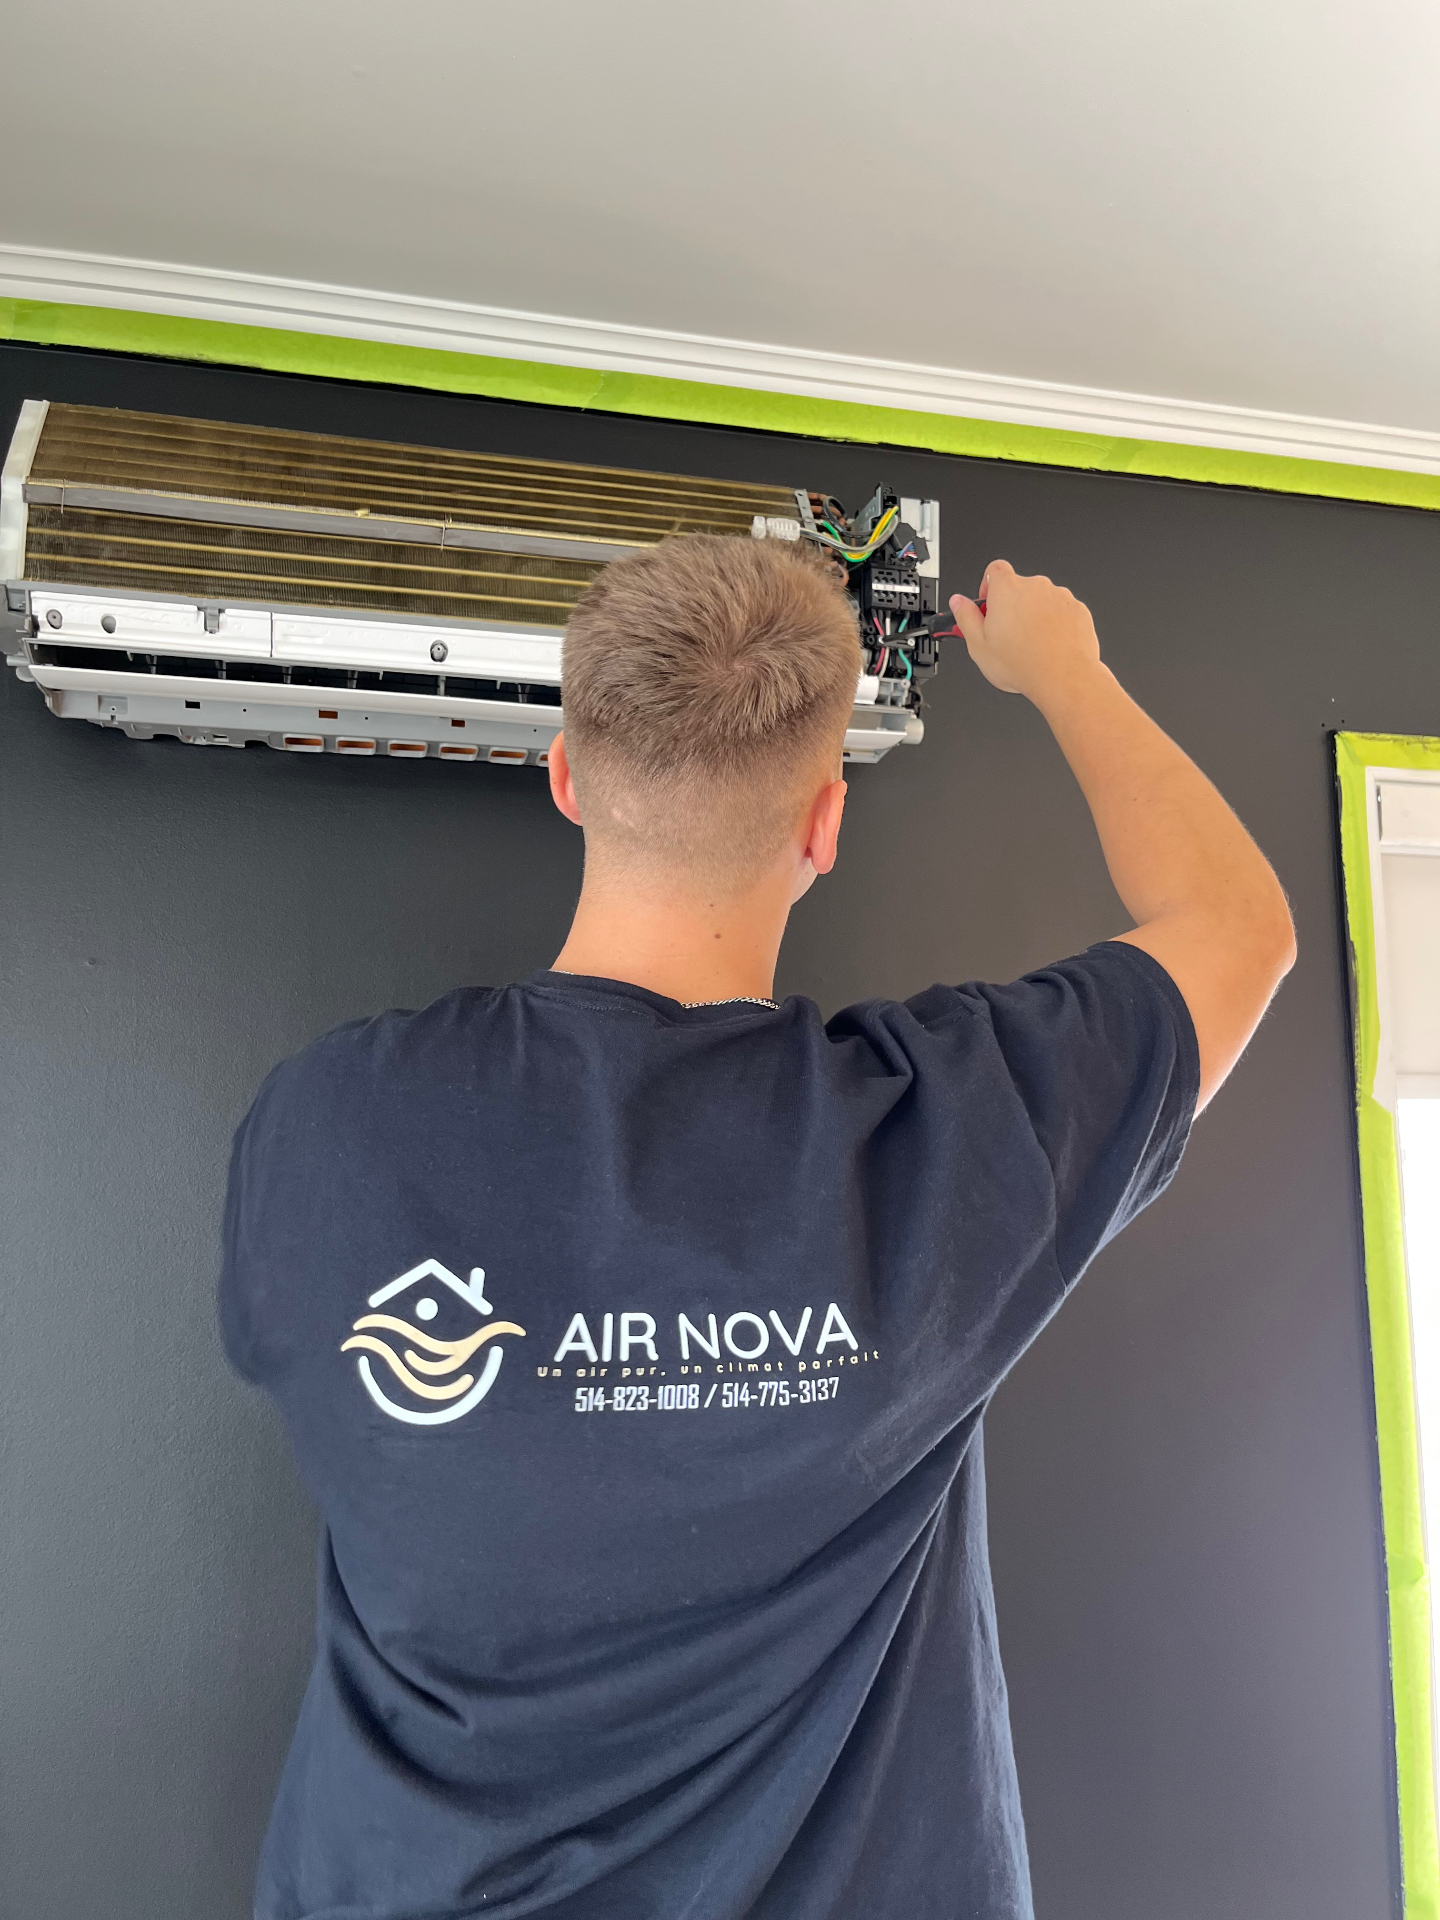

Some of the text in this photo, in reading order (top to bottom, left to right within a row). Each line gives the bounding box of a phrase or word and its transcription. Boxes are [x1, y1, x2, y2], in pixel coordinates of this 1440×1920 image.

[553, 1302, 860, 1363] AIR NOVA
[576, 1366, 608, 1378] air
[680, 1364, 702, 1375] un
[716, 1361, 783, 1373] climat
[798, 1349, 879, 1373] parfait
[574, 1376, 840, 1412] 514-823-1008 / 514-775-3137
